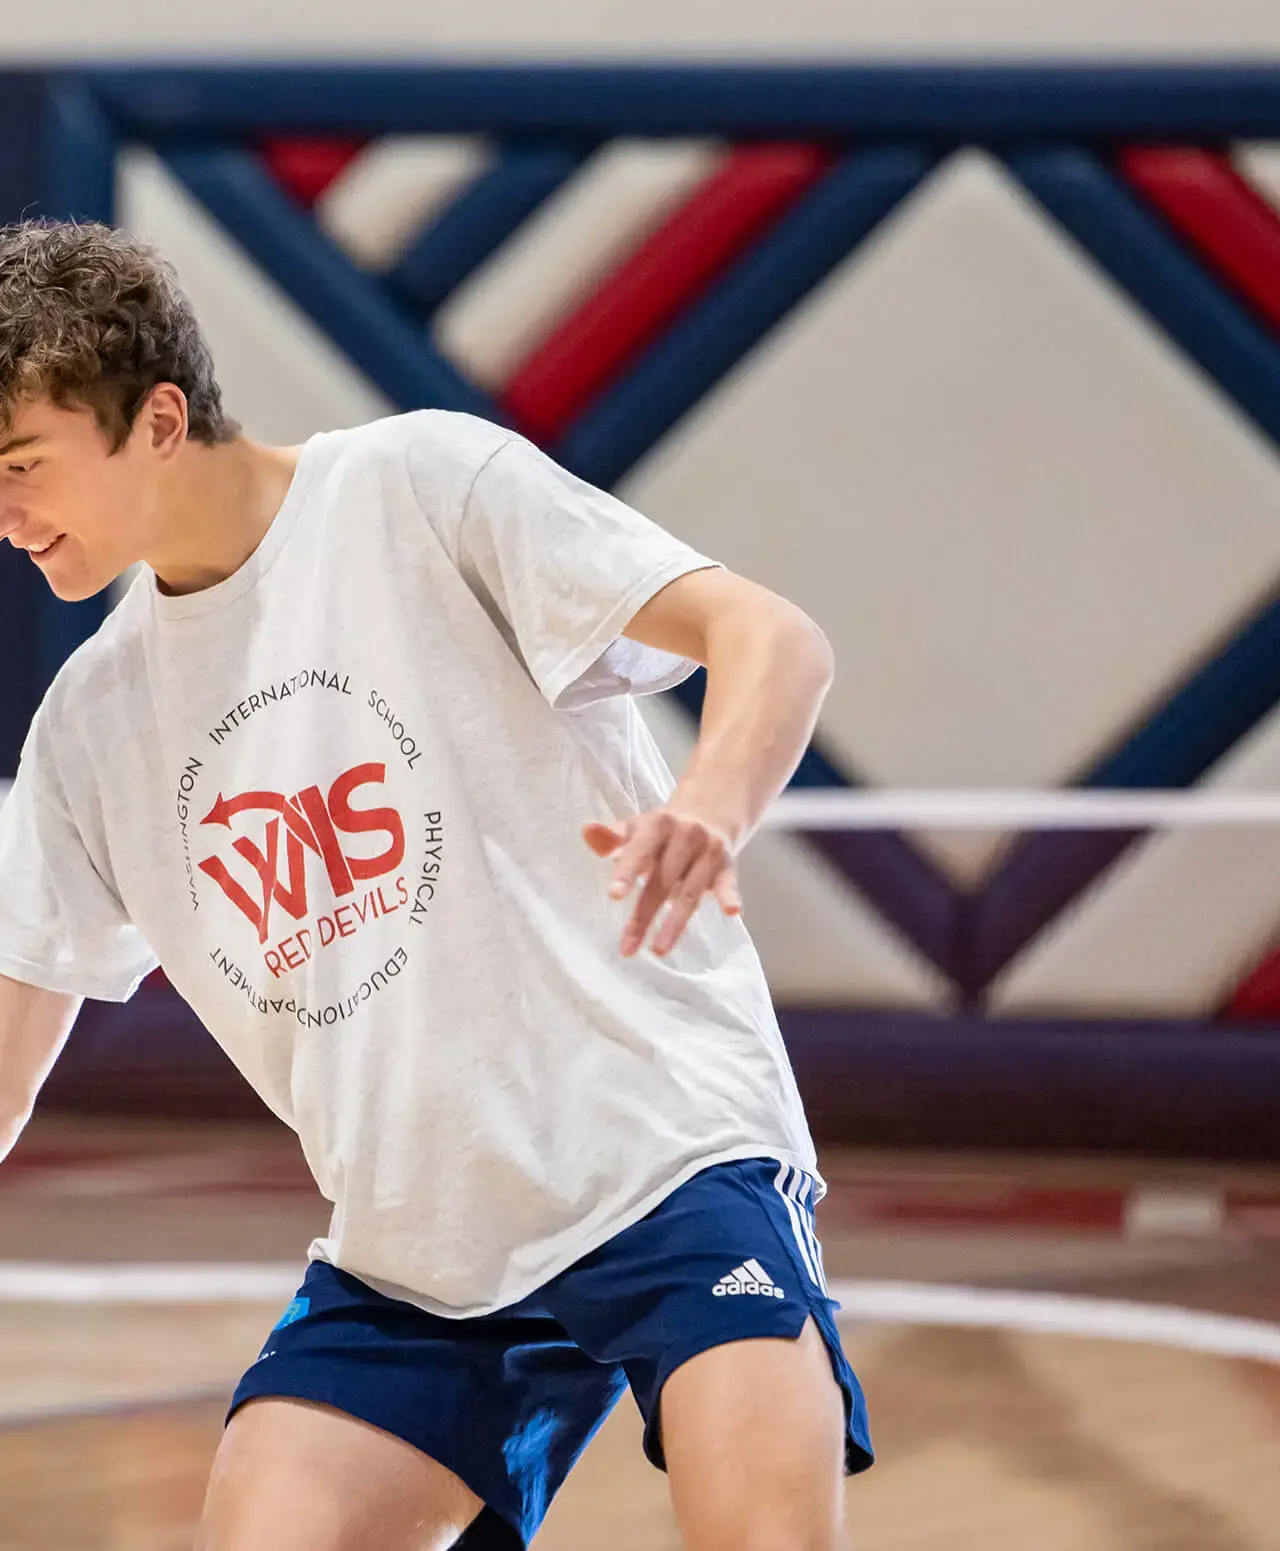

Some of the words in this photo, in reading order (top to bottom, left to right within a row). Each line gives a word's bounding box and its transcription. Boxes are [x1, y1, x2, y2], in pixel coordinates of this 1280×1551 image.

[368, 690, 422, 770] SCHOOL
[408, 811, 443, 924] PHYSICAL
[264, 929, 312, 979] RED
[317, 876, 408, 947] DEVILS
[209, 948, 307, 1026] DPARTMENT
[306, 947, 408, 1028] EDUCATION
[712, 1281, 785, 1299] adidas
